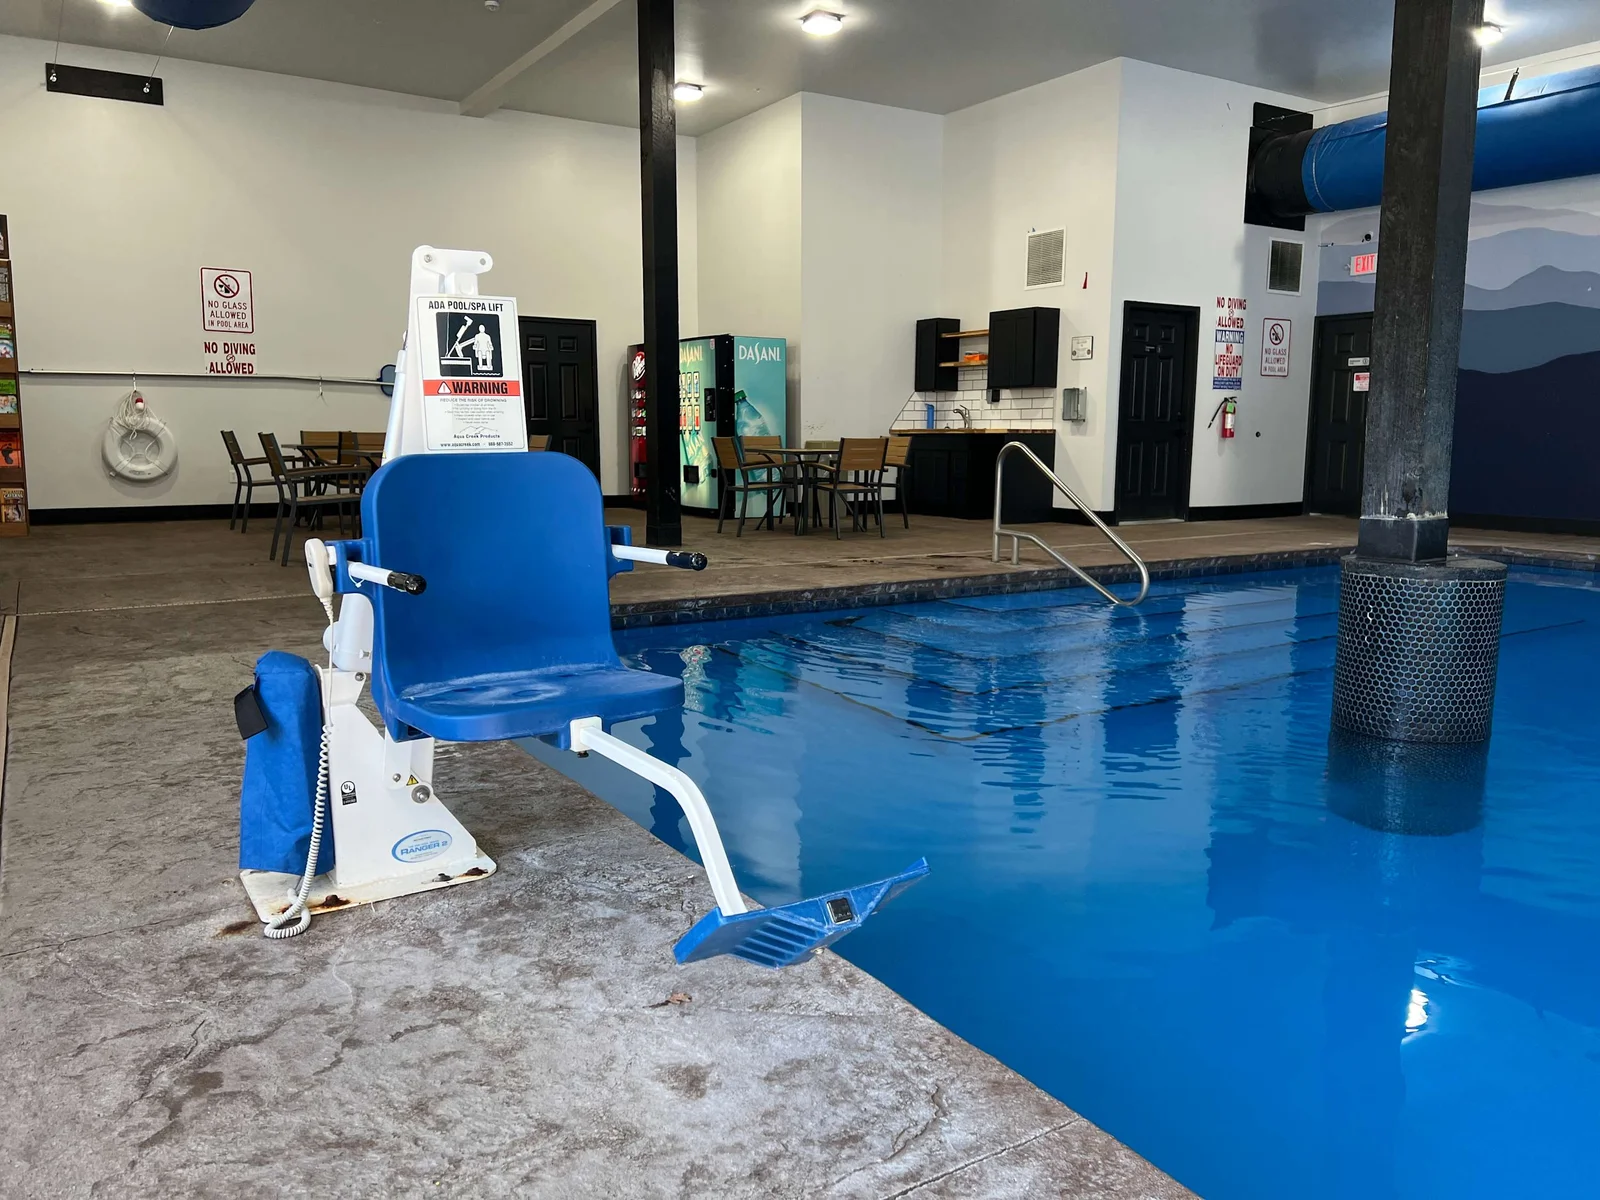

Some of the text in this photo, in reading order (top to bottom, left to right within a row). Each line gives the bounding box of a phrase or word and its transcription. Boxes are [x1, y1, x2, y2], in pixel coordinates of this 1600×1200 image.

[1354, 255, 1375, 273] EXIT
[222, 301, 247, 310] GLASS
[428, 300, 503, 312] ADA POOL/SPA LIFT
[1216, 296, 1246, 310] NO DIVING
[210, 310, 246, 320] ALLOWED
[1217, 316, 1244, 328] ALLOWED
[1216, 330, 1244, 343] WARNING
[204, 342, 255, 355] NO DIVING
[738, 342, 781, 364] DASANI
[1226, 344, 1233, 354] NO
[1215, 355, 1242, 366] LIFEGUARD
[209, 362, 254, 374] ALLOWED
[1217, 366, 1239, 377] ON DUTY
[452, 382, 508, 394] WARNING
[401, 842, 440, 855] RANGER
